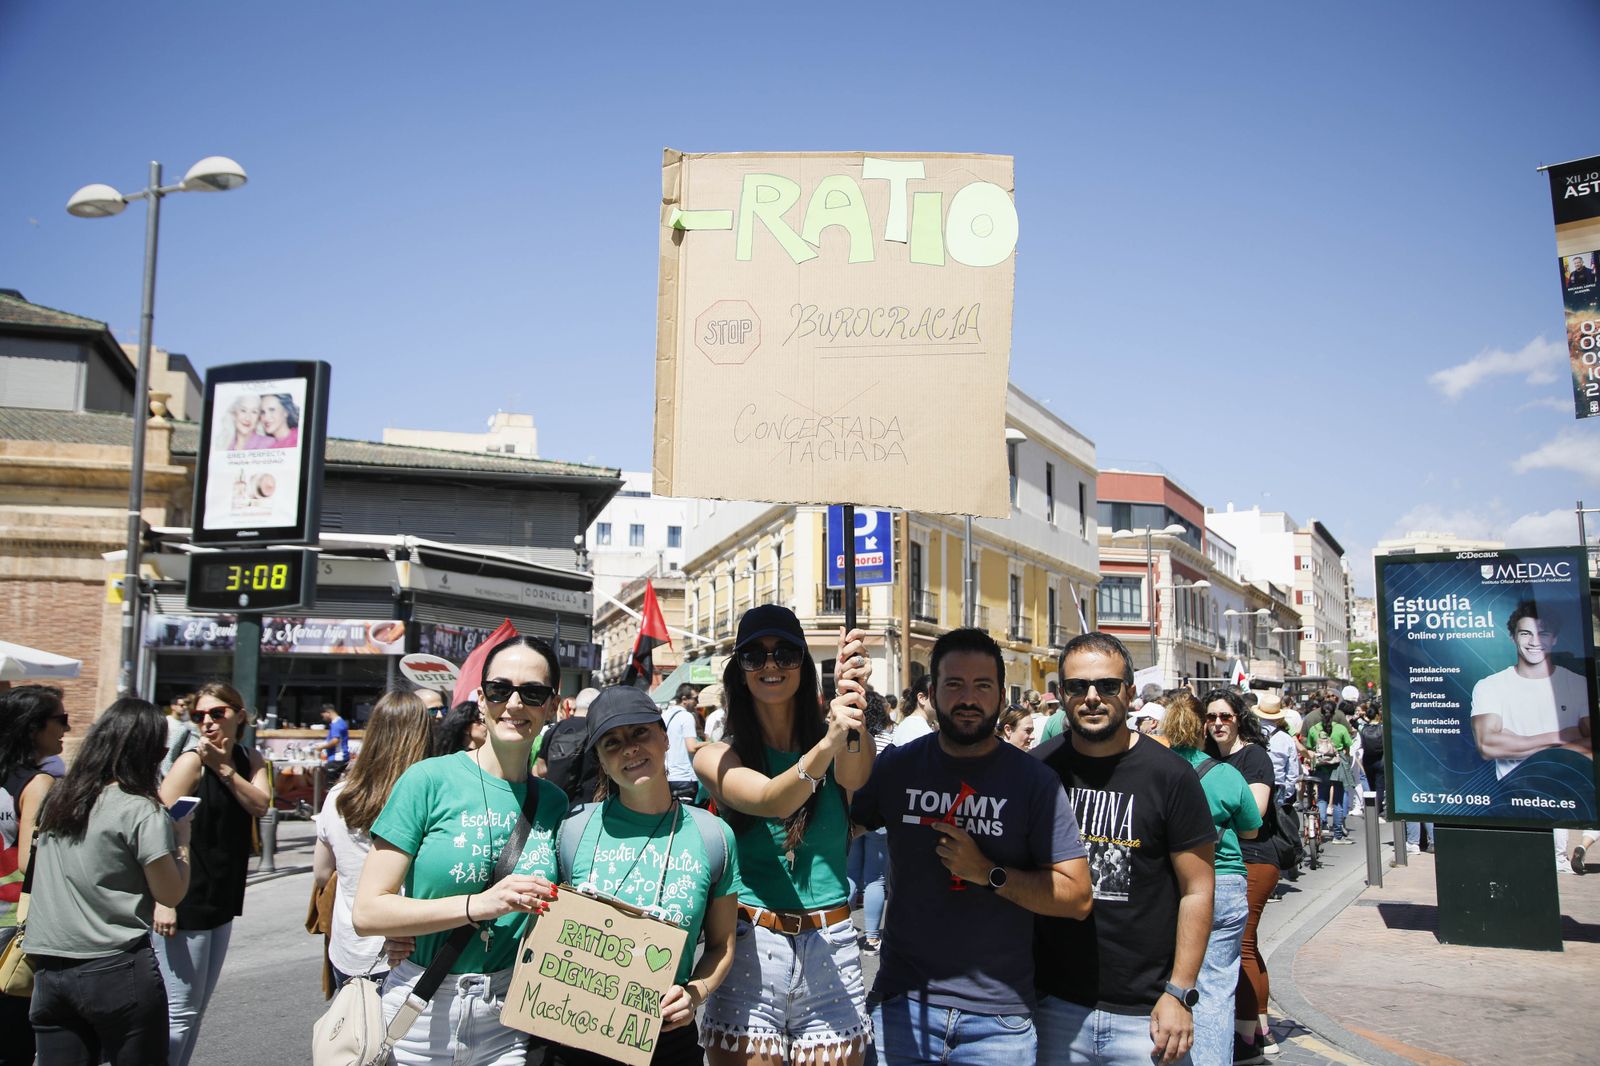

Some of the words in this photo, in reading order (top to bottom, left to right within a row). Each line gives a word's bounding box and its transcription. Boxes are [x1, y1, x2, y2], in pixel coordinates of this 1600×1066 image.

[1564, 180, 1600, 199] AST
[1566, 175, 1581, 185] XII
[704, 319, 752, 345] STOP
[783, 303, 981, 346] BUROCRACIA
[733, 404, 904, 443] CONCERTADA
[784, 441, 909, 465] TACHADA
[1456, 551, 1499, 560] JCDecaux
[226, 564, 288, 590] 3:08
[1496, 562, 1571, 579] MEDAC
[524, 587, 577, 604] CORNELIA'S
[1393, 594, 1471, 613] Estudia
[1394, 613, 1420, 630] FP
[1426, 611, 1494, 630] Oficial
[202, 622, 239, 641] Sevil
[323, 624, 347, 643] hija
[1408, 631, 1437, 640] Online
[1439, 633, 1445, 641] y
[1447, 630, 1495, 641] presencial
[1409, 666, 1460, 674] Instalaciones
[1410, 675, 1443, 683] punteras
[1411, 692, 1446, 700] Prácticas
[1411, 701, 1460, 709] garantizadas
[1412, 717, 1460, 725] Financiación
[906, 788, 1007, 819] TOMMY
[1412, 793, 1436, 804] 651
[1439, 794, 1463, 804] 760
[1466, 795, 1490, 806] 088
[1511, 796, 1576, 809] medac.es
[462, 811, 510, 831] ESCUELA
[953, 816, 1004, 837] EANS
[472, 844, 492, 857] DE
[594, 845, 648, 865] ESCUELA
[456, 869, 489, 884] PAR
[604, 879, 623, 892] DE
[557, 918, 635, 968] RATIOS
[622, 981, 662, 1018] PARA
[519, 981, 599, 1034] Maestr@s
[600, 1007, 616, 1038] de
[618, 1014, 654, 1052] AL
